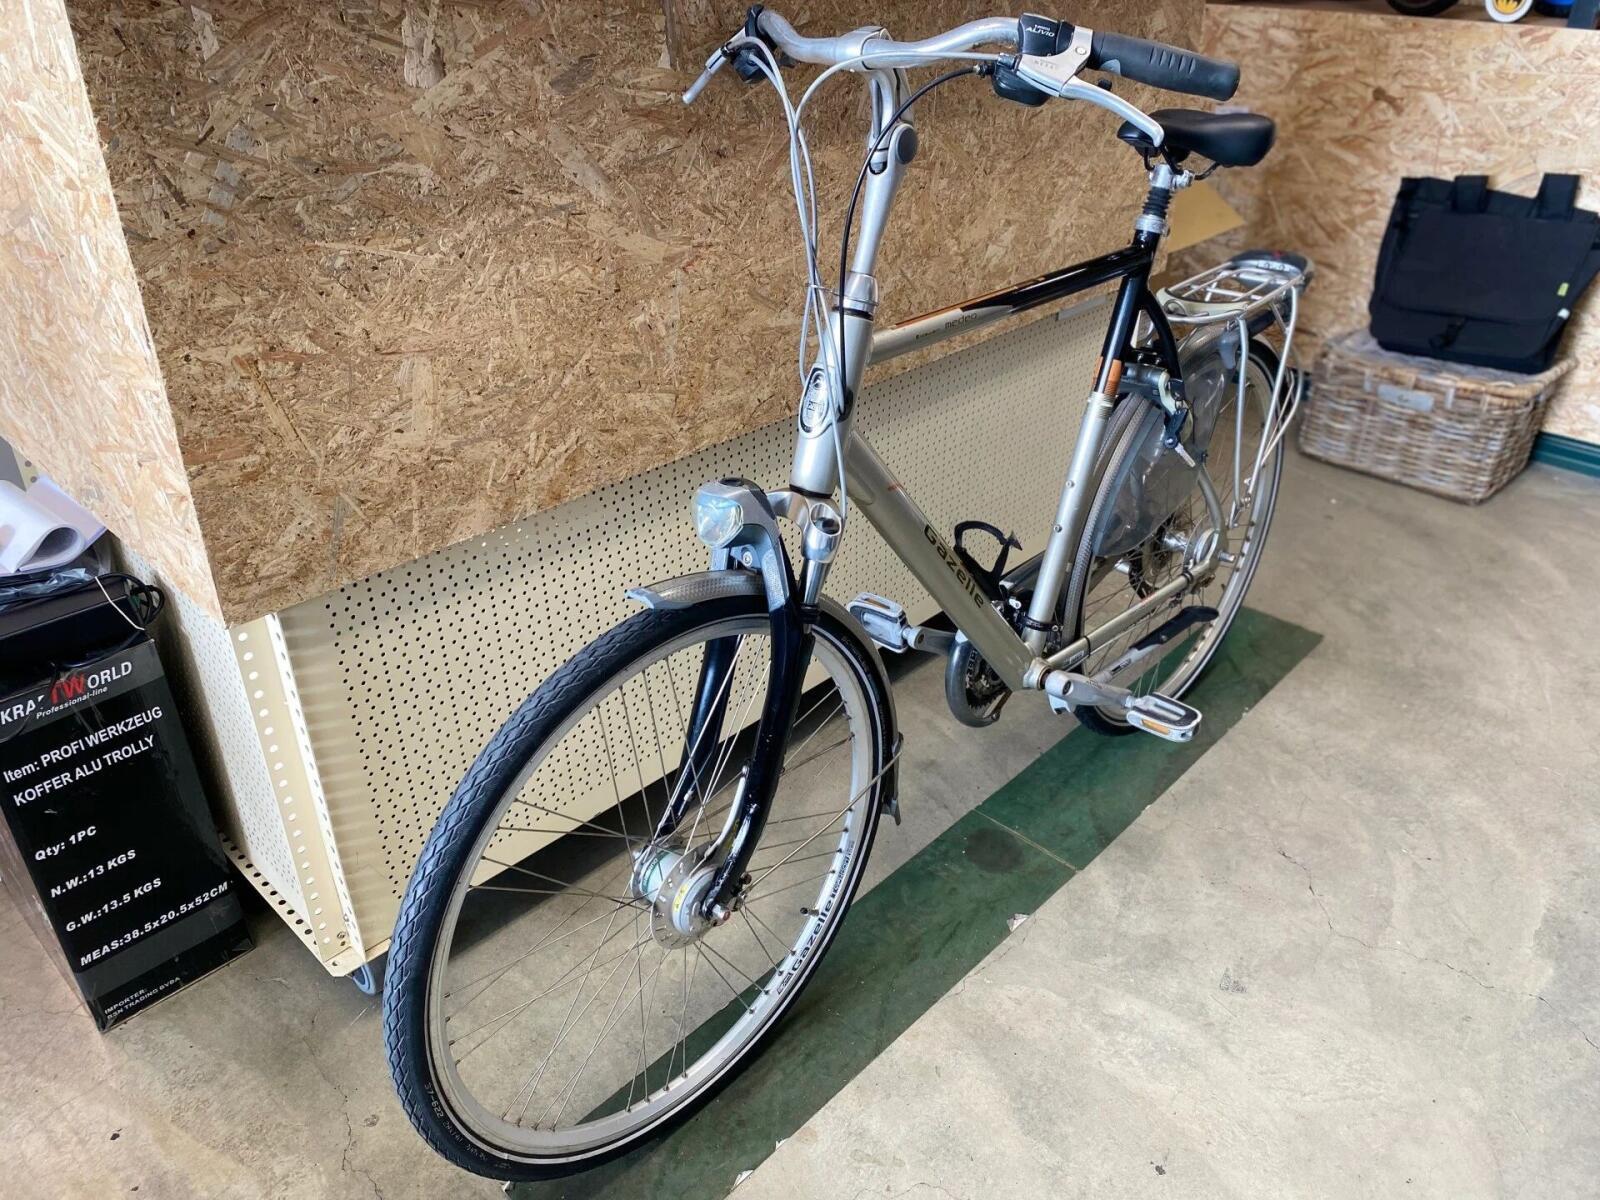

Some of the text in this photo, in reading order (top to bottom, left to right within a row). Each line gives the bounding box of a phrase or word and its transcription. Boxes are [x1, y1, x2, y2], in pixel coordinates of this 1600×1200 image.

[924, 524, 984, 609] Gazelle
[36, 686, 108, 720] Professional-line
[3, 706, 163, 784] Item: PROFI WERKZEUG
[13, 735, 155, 807] KOFFER ALU TROLLY
[35, 825, 97, 861] Qty: 1PC
[107, 849, 137, 870] KGS
[80, 881, 229, 967] MEAS:38.5x20.5x52CM
[134, 877, 163, 899] KGS
[791, 900, 834, 972] Gazelle
